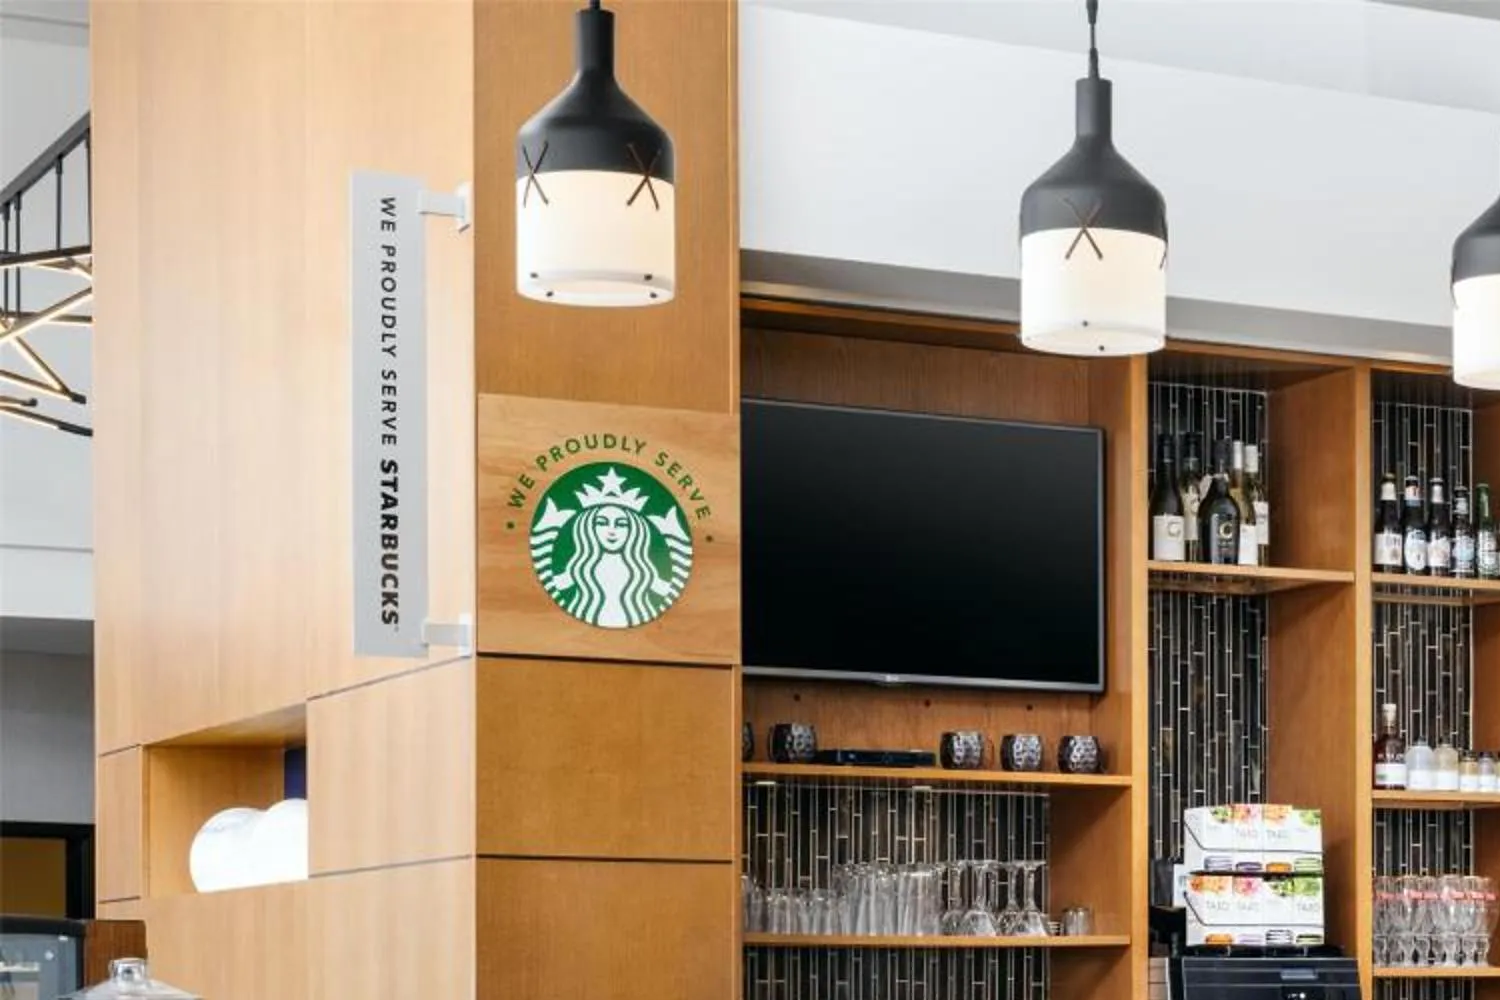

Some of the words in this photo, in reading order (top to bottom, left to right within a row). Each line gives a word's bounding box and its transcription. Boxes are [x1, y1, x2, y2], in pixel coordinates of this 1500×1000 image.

[380, 196, 397, 232] WE
[381, 245, 398, 359] PROUDLY
[381, 368, 398, 446] SERVE
[507, 474, 535, 510] WE
[536, 433, 647, 473] PROUDLY
[655, 451, 712, 520] SERVE
[379, 458, 399, 627] STARBUCKS
